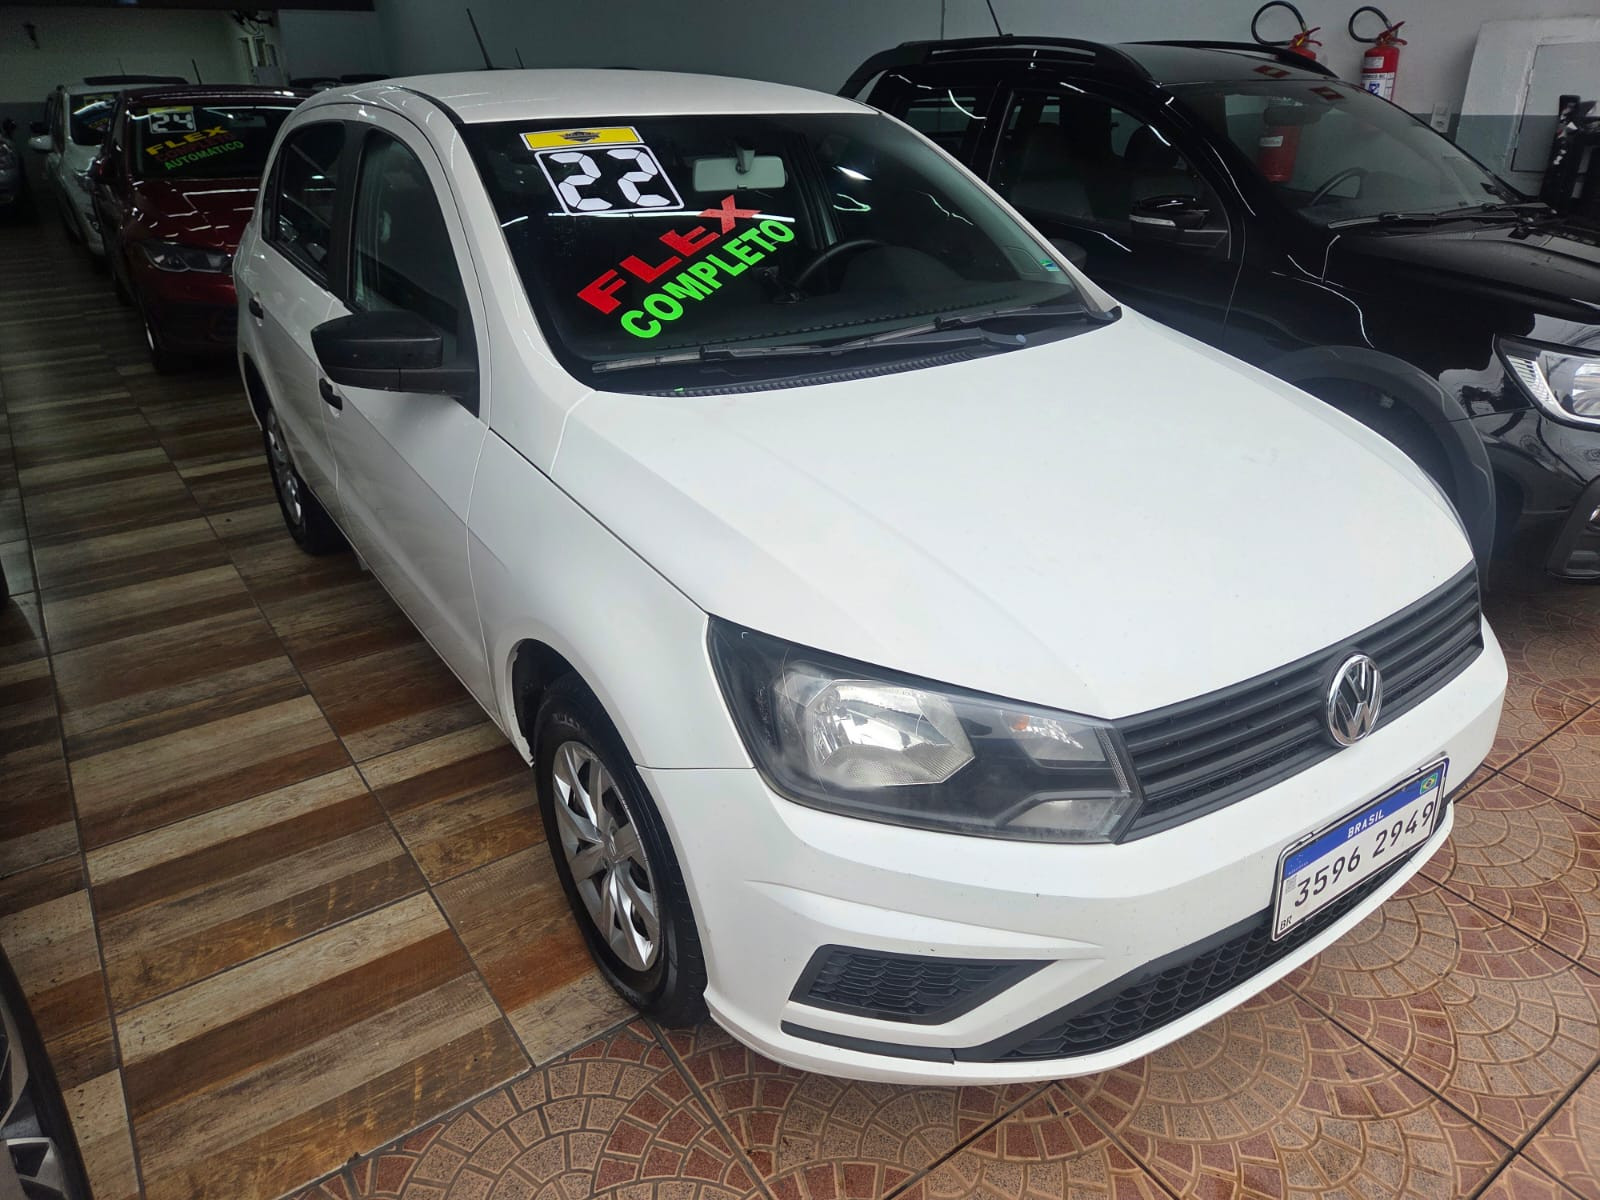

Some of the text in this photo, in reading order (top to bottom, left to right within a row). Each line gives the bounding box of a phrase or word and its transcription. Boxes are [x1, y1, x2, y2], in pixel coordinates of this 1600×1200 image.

[151, 113, 194, 131] 24
[146, 126, 229, 155] FLEX
[164, 140, 244, 170] AUTOMATICO
[549, 149, 671, 210] 22
[577, 194, 761, 314] FLEX
[620, 219, 795, 338] COMPLETO
[1347, 808, 1385, 839] BRASIL
[1295, 801, 1435, 907] 3596 2949
[1279, 915, 1293, 931] BR
